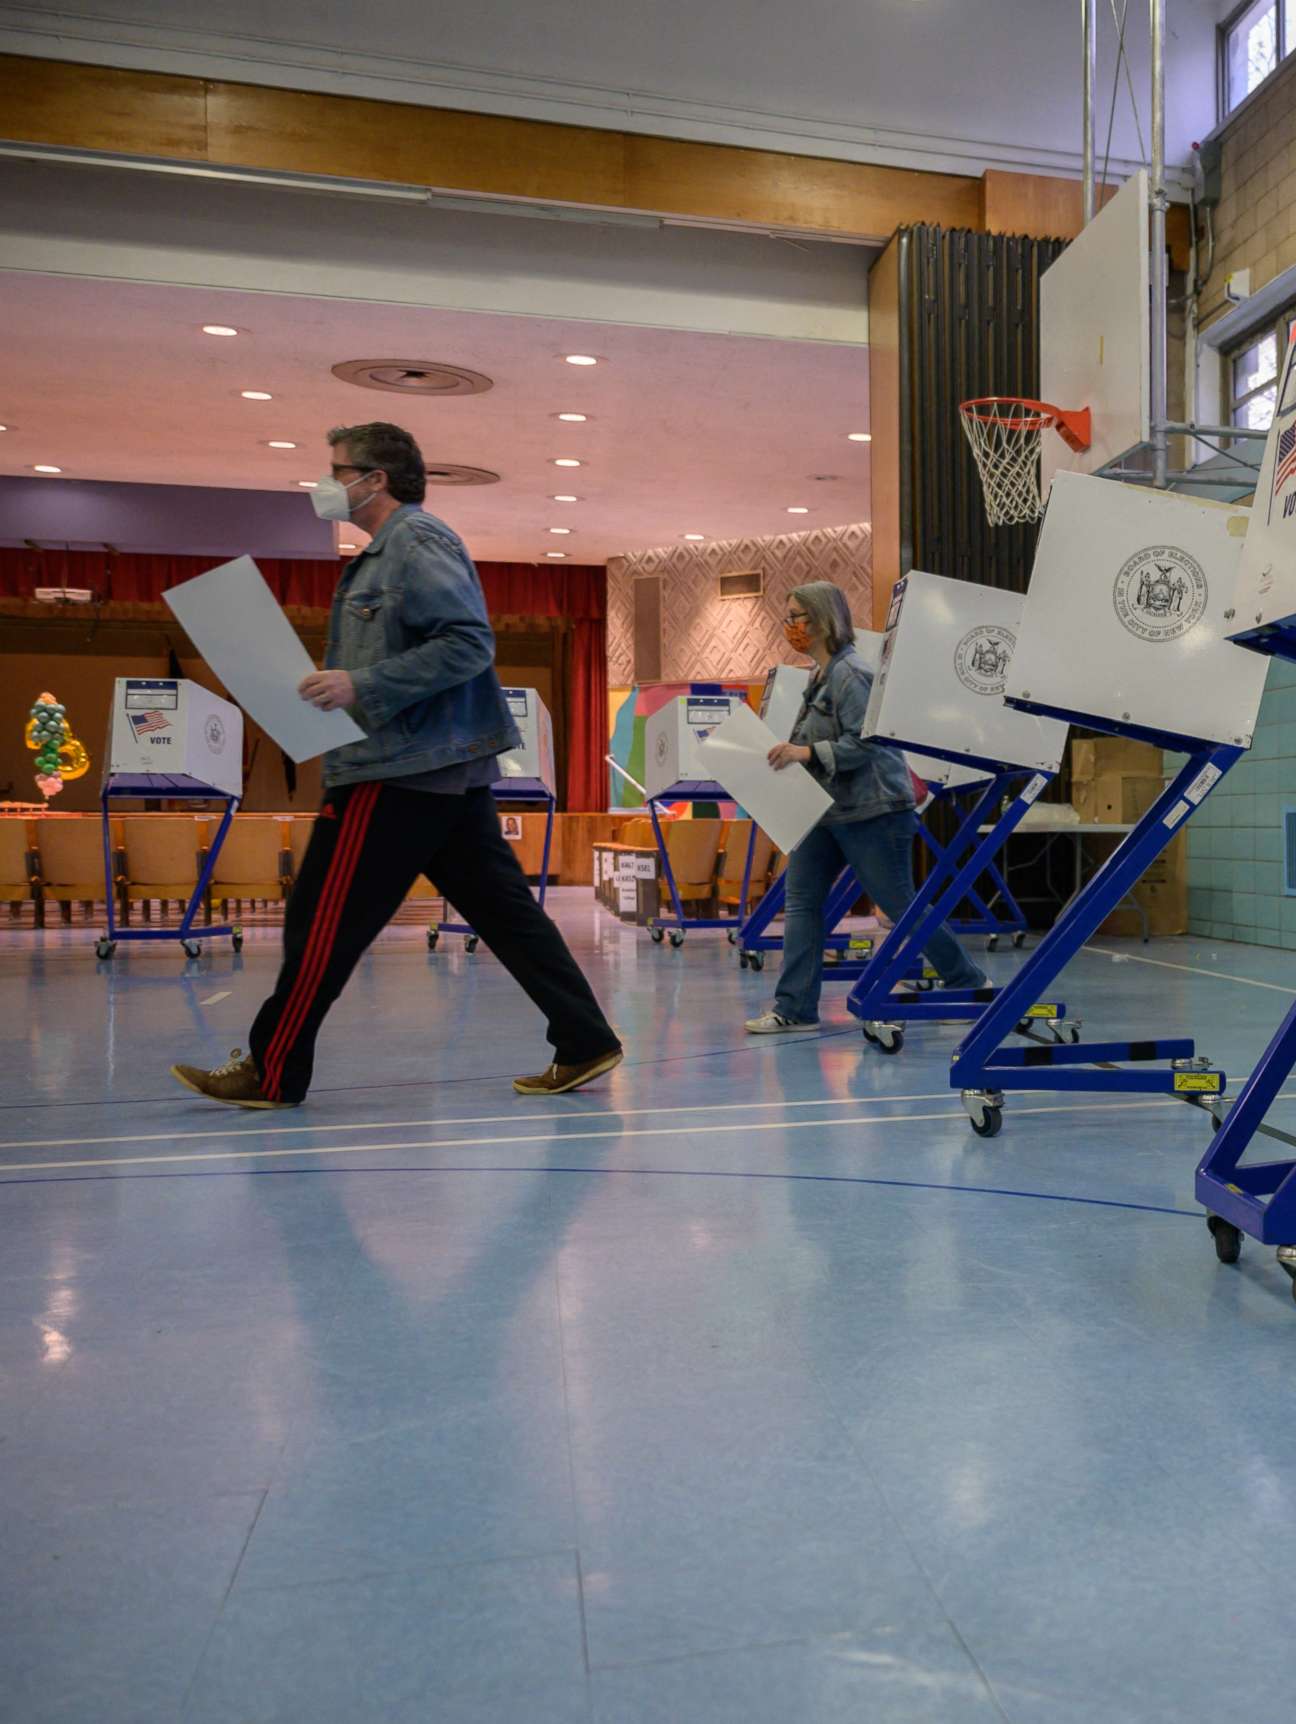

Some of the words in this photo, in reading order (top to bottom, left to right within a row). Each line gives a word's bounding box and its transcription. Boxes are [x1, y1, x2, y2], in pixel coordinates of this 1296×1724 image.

[1123, 552, 1151, 578] BOARD
[1152, 550, 1166, 558] OF
[150, 736, 172, 745] VOTE
